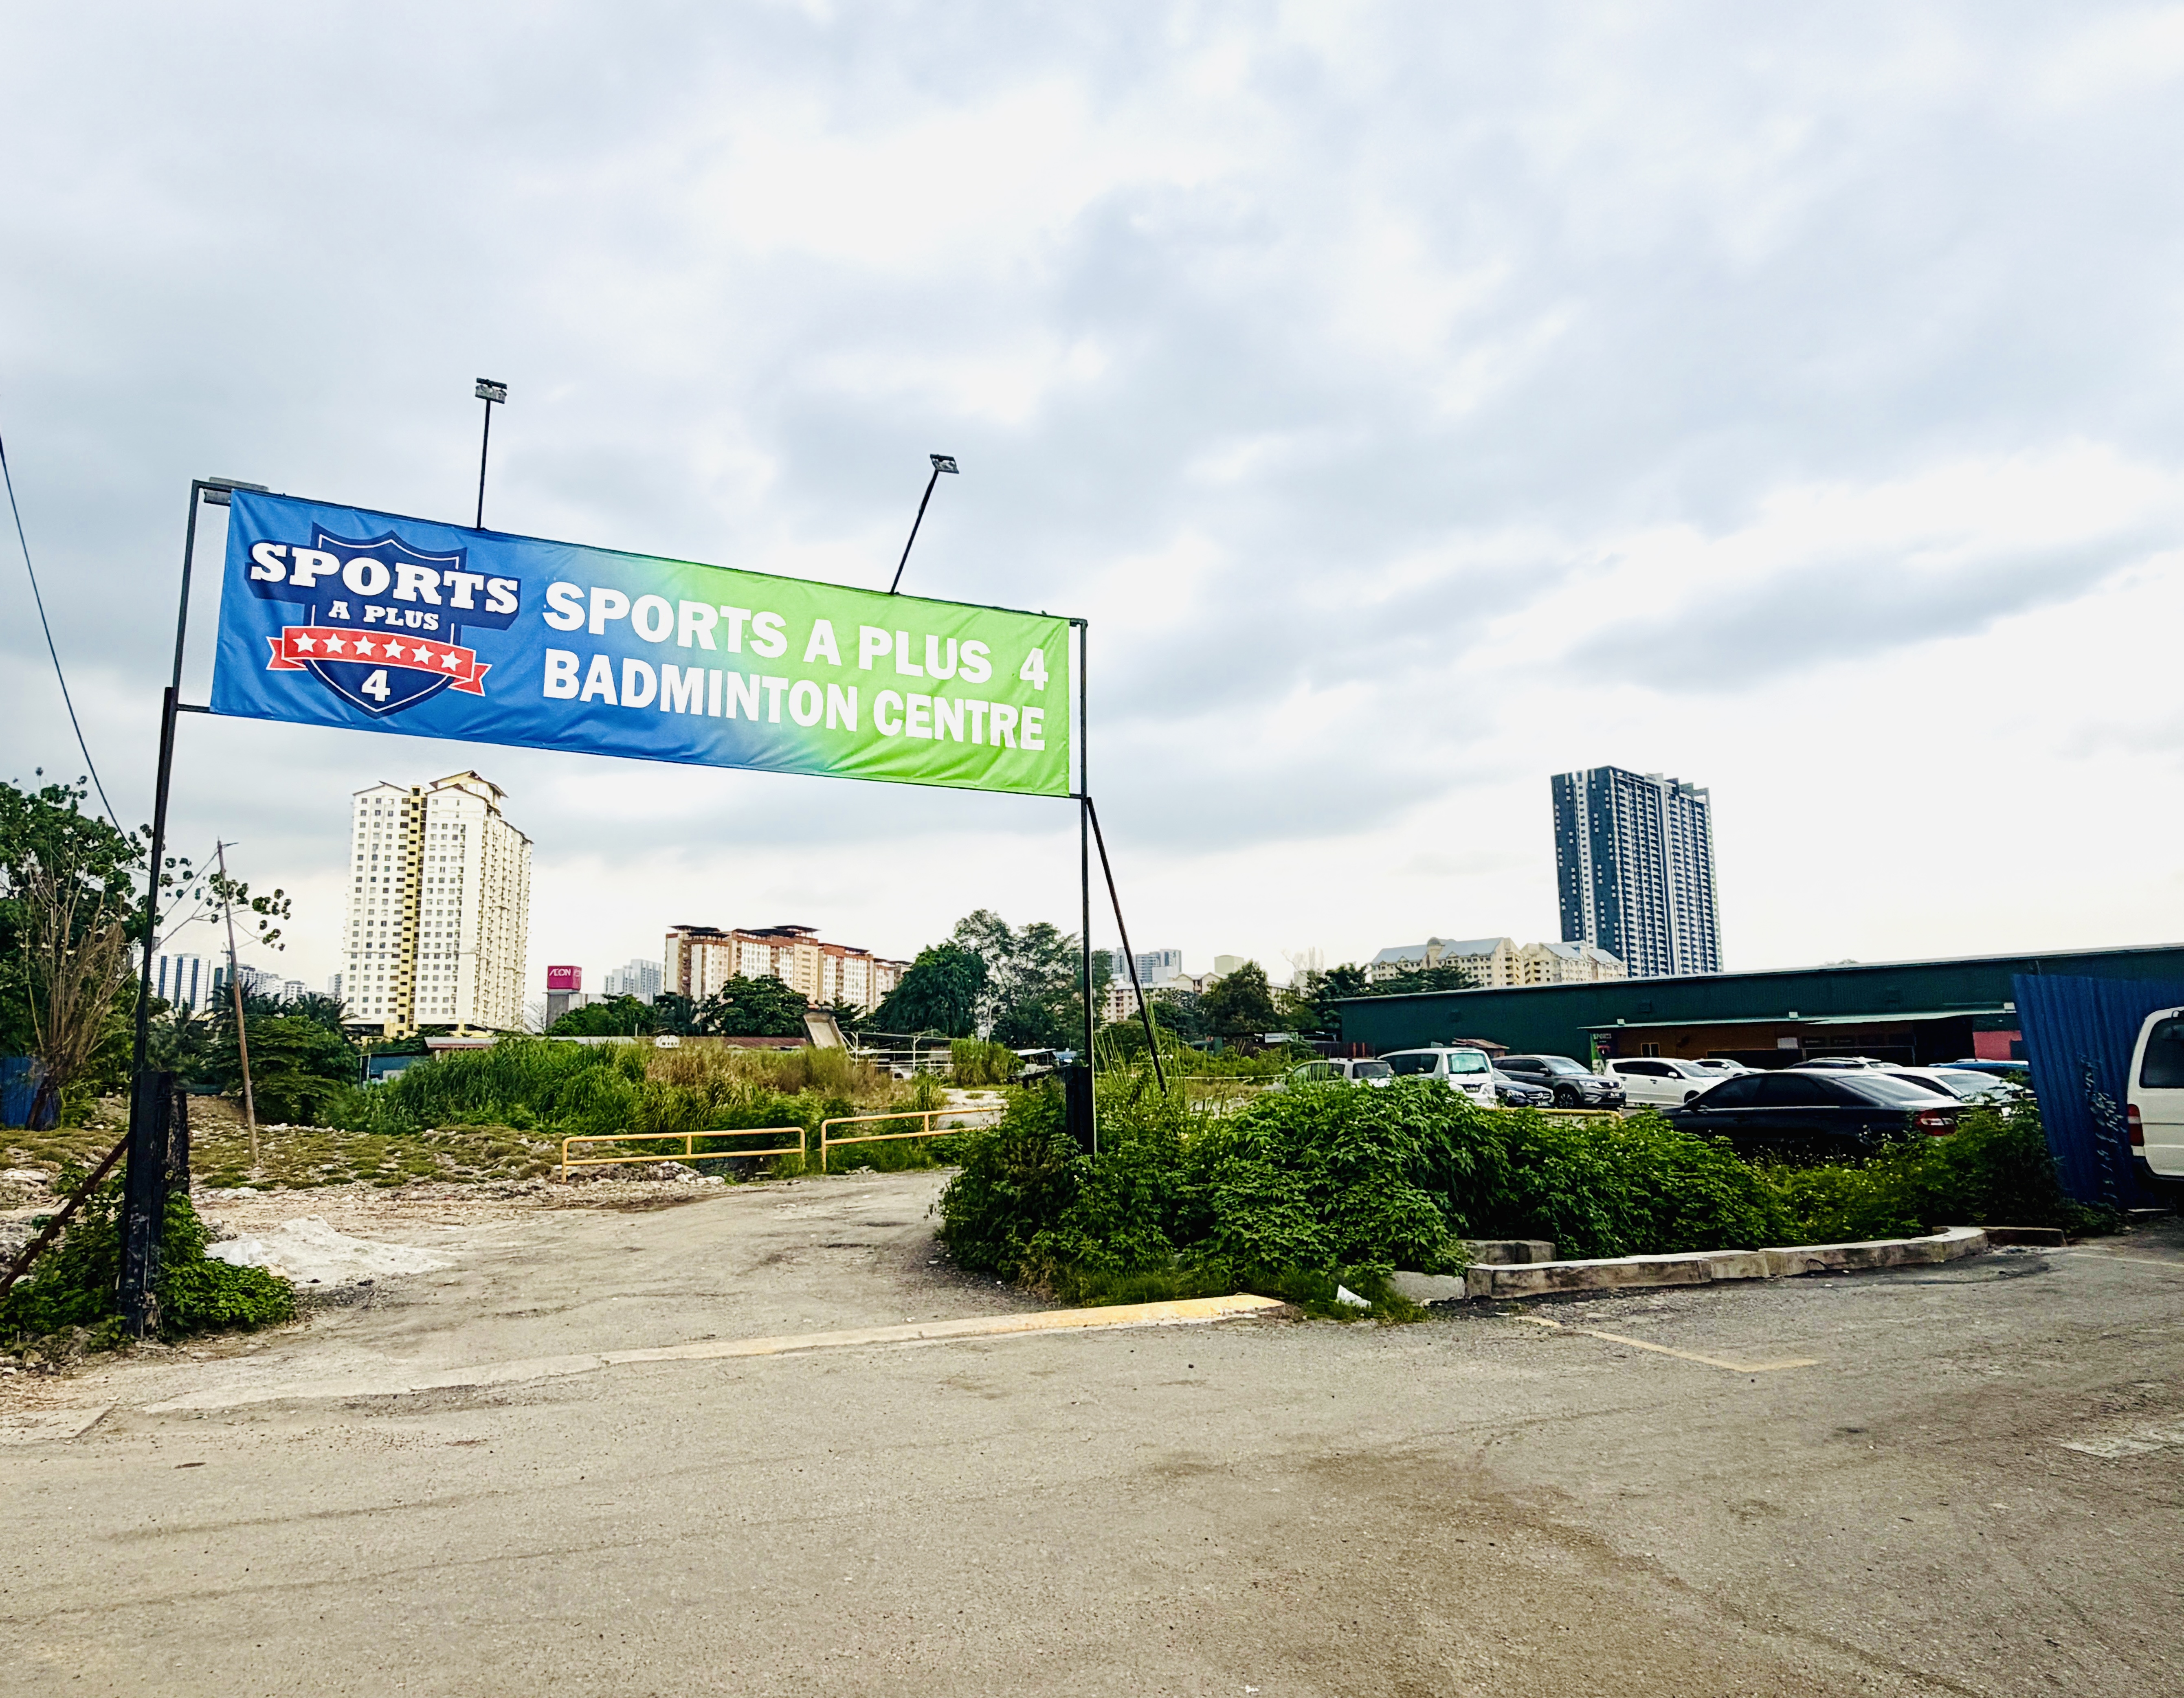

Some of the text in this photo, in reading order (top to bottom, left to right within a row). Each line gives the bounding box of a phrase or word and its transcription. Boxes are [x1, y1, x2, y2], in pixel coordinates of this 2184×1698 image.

[251, 543, 518, 614] SPORTS
[329, 600, 439, 630] A PLUS
[543, 582, 1049, 691] SPORTS A PLUS 4
[361, 670, 391, 701] 4
[543, 648, 1045, 751] BADMINTON CENTRE
